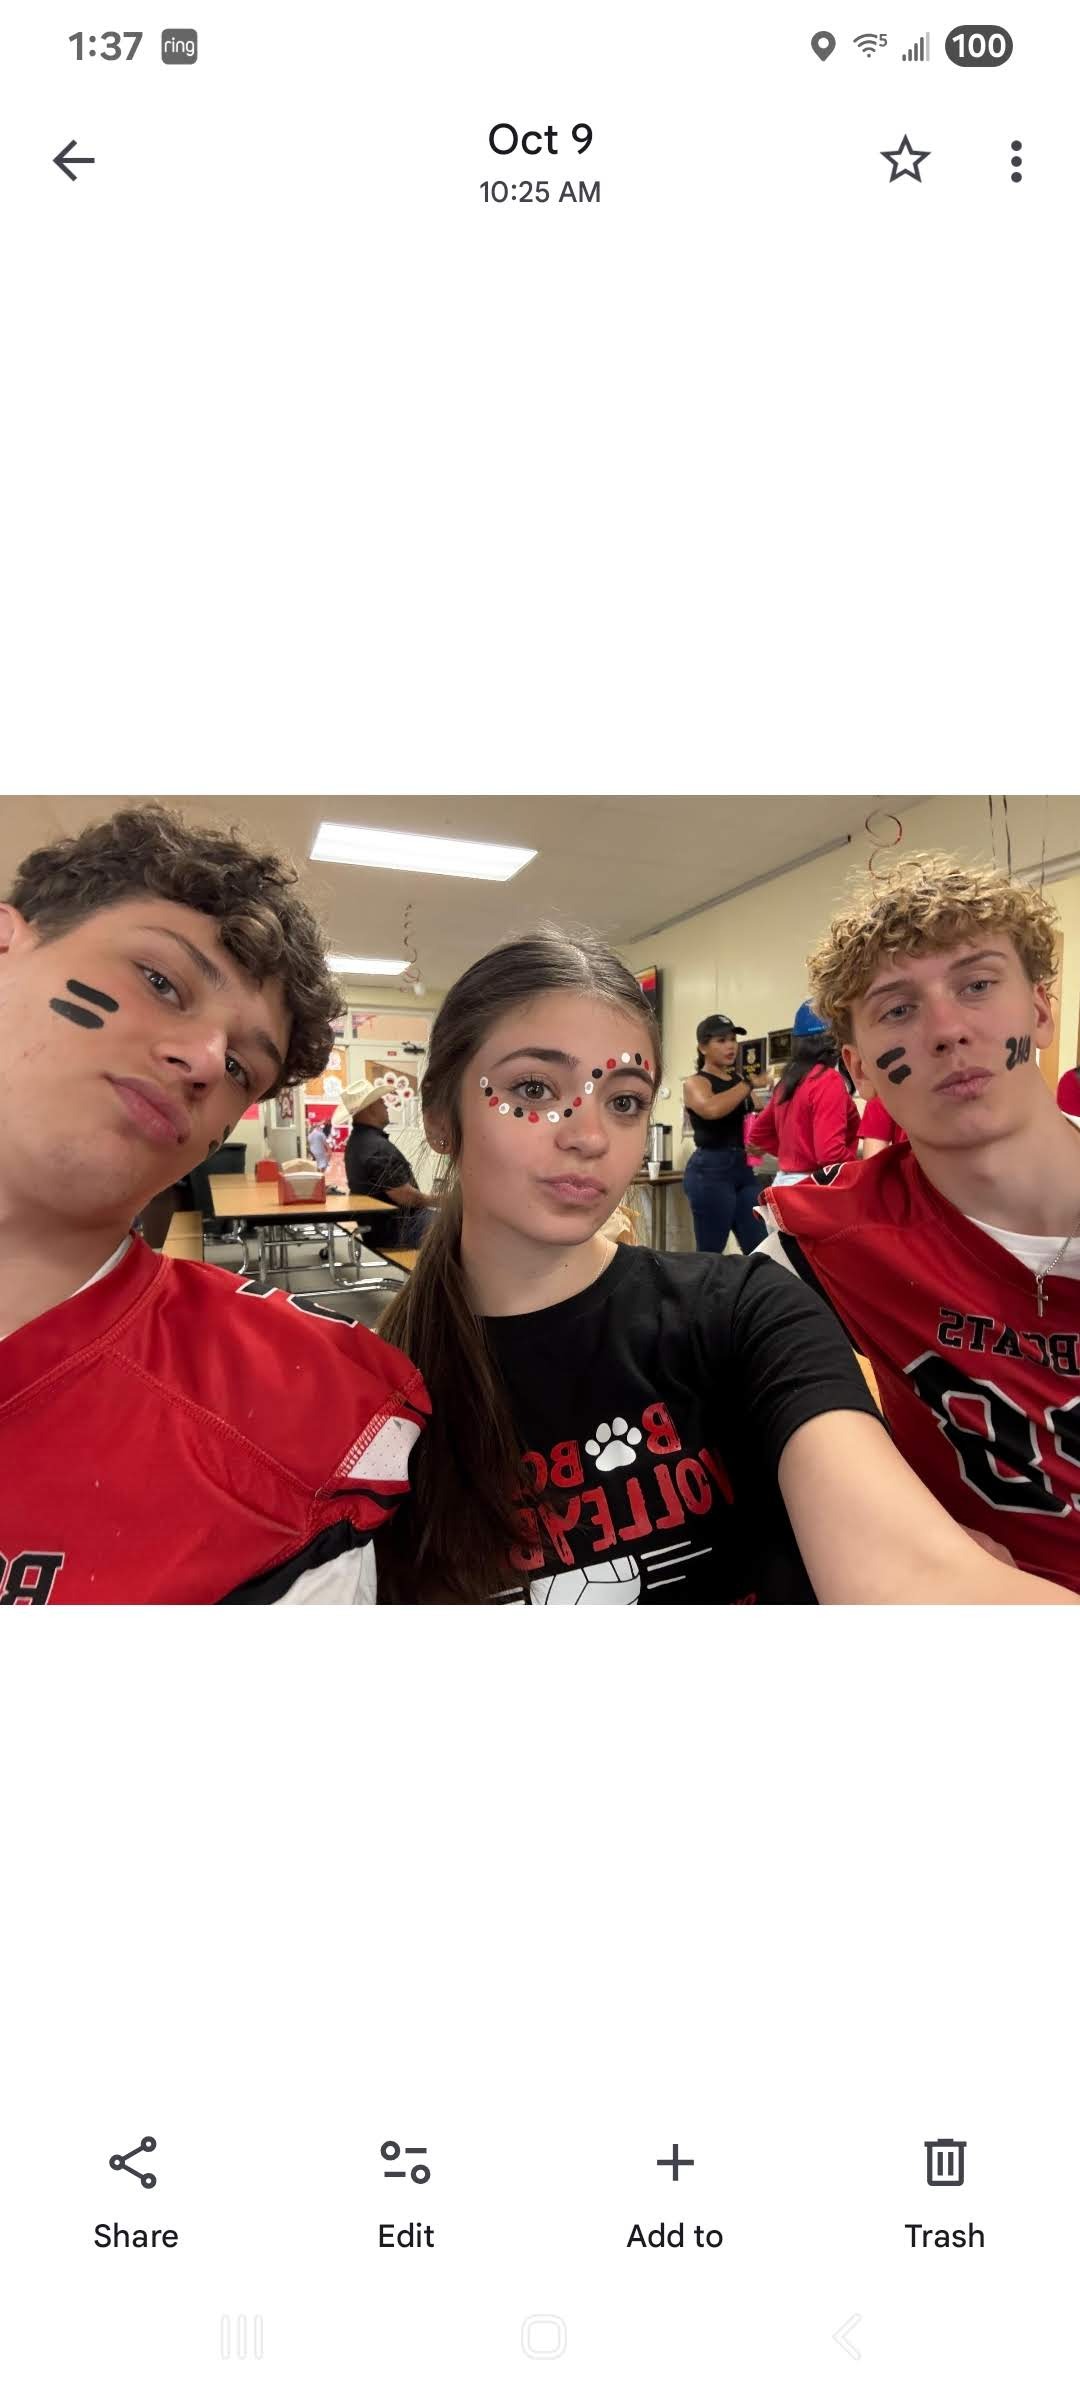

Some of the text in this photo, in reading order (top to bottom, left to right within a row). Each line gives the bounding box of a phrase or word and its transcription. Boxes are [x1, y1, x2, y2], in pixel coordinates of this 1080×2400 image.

[68, 31, 143, 61] 1:37
[164, 36, 195, 57] ring
[951, 33, 1007, 58] 100
[488, 122, 593, 156] Oct 9
[479, 180, 601, 203] 10:25 AM
[94, 2222, 179, 2248] Share
[379, 2222, 435, 2248] Edit
[626, 2221, 724, 2249] Add to
[904, 2222, 985, 2248] Trash
